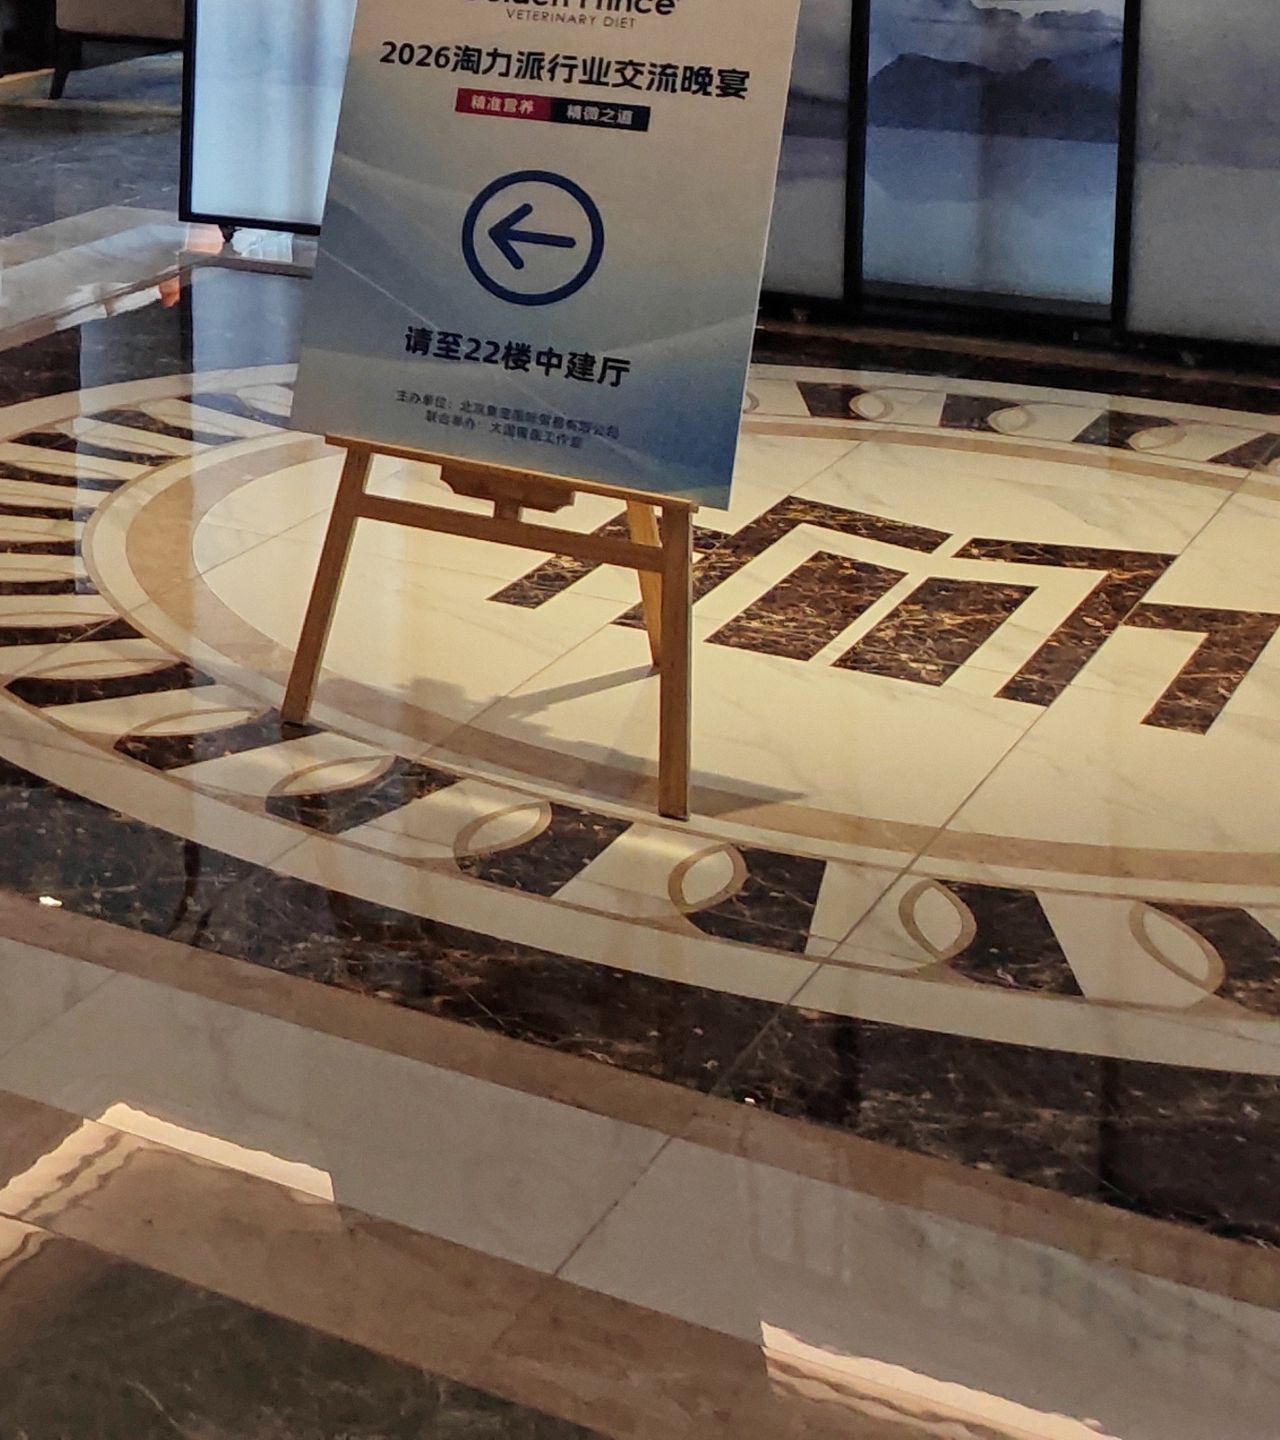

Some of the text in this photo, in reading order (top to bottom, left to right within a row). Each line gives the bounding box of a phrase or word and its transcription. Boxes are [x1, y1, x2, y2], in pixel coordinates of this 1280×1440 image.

[506, 8, 638, 30] VETERINARY DIET
[379, 40, 752, 100] 2026淘力派行业交流晚宴
[470, 94, 535, 115] 精准营养
[404, 325, 632, 388] 请至22楼中建厅
